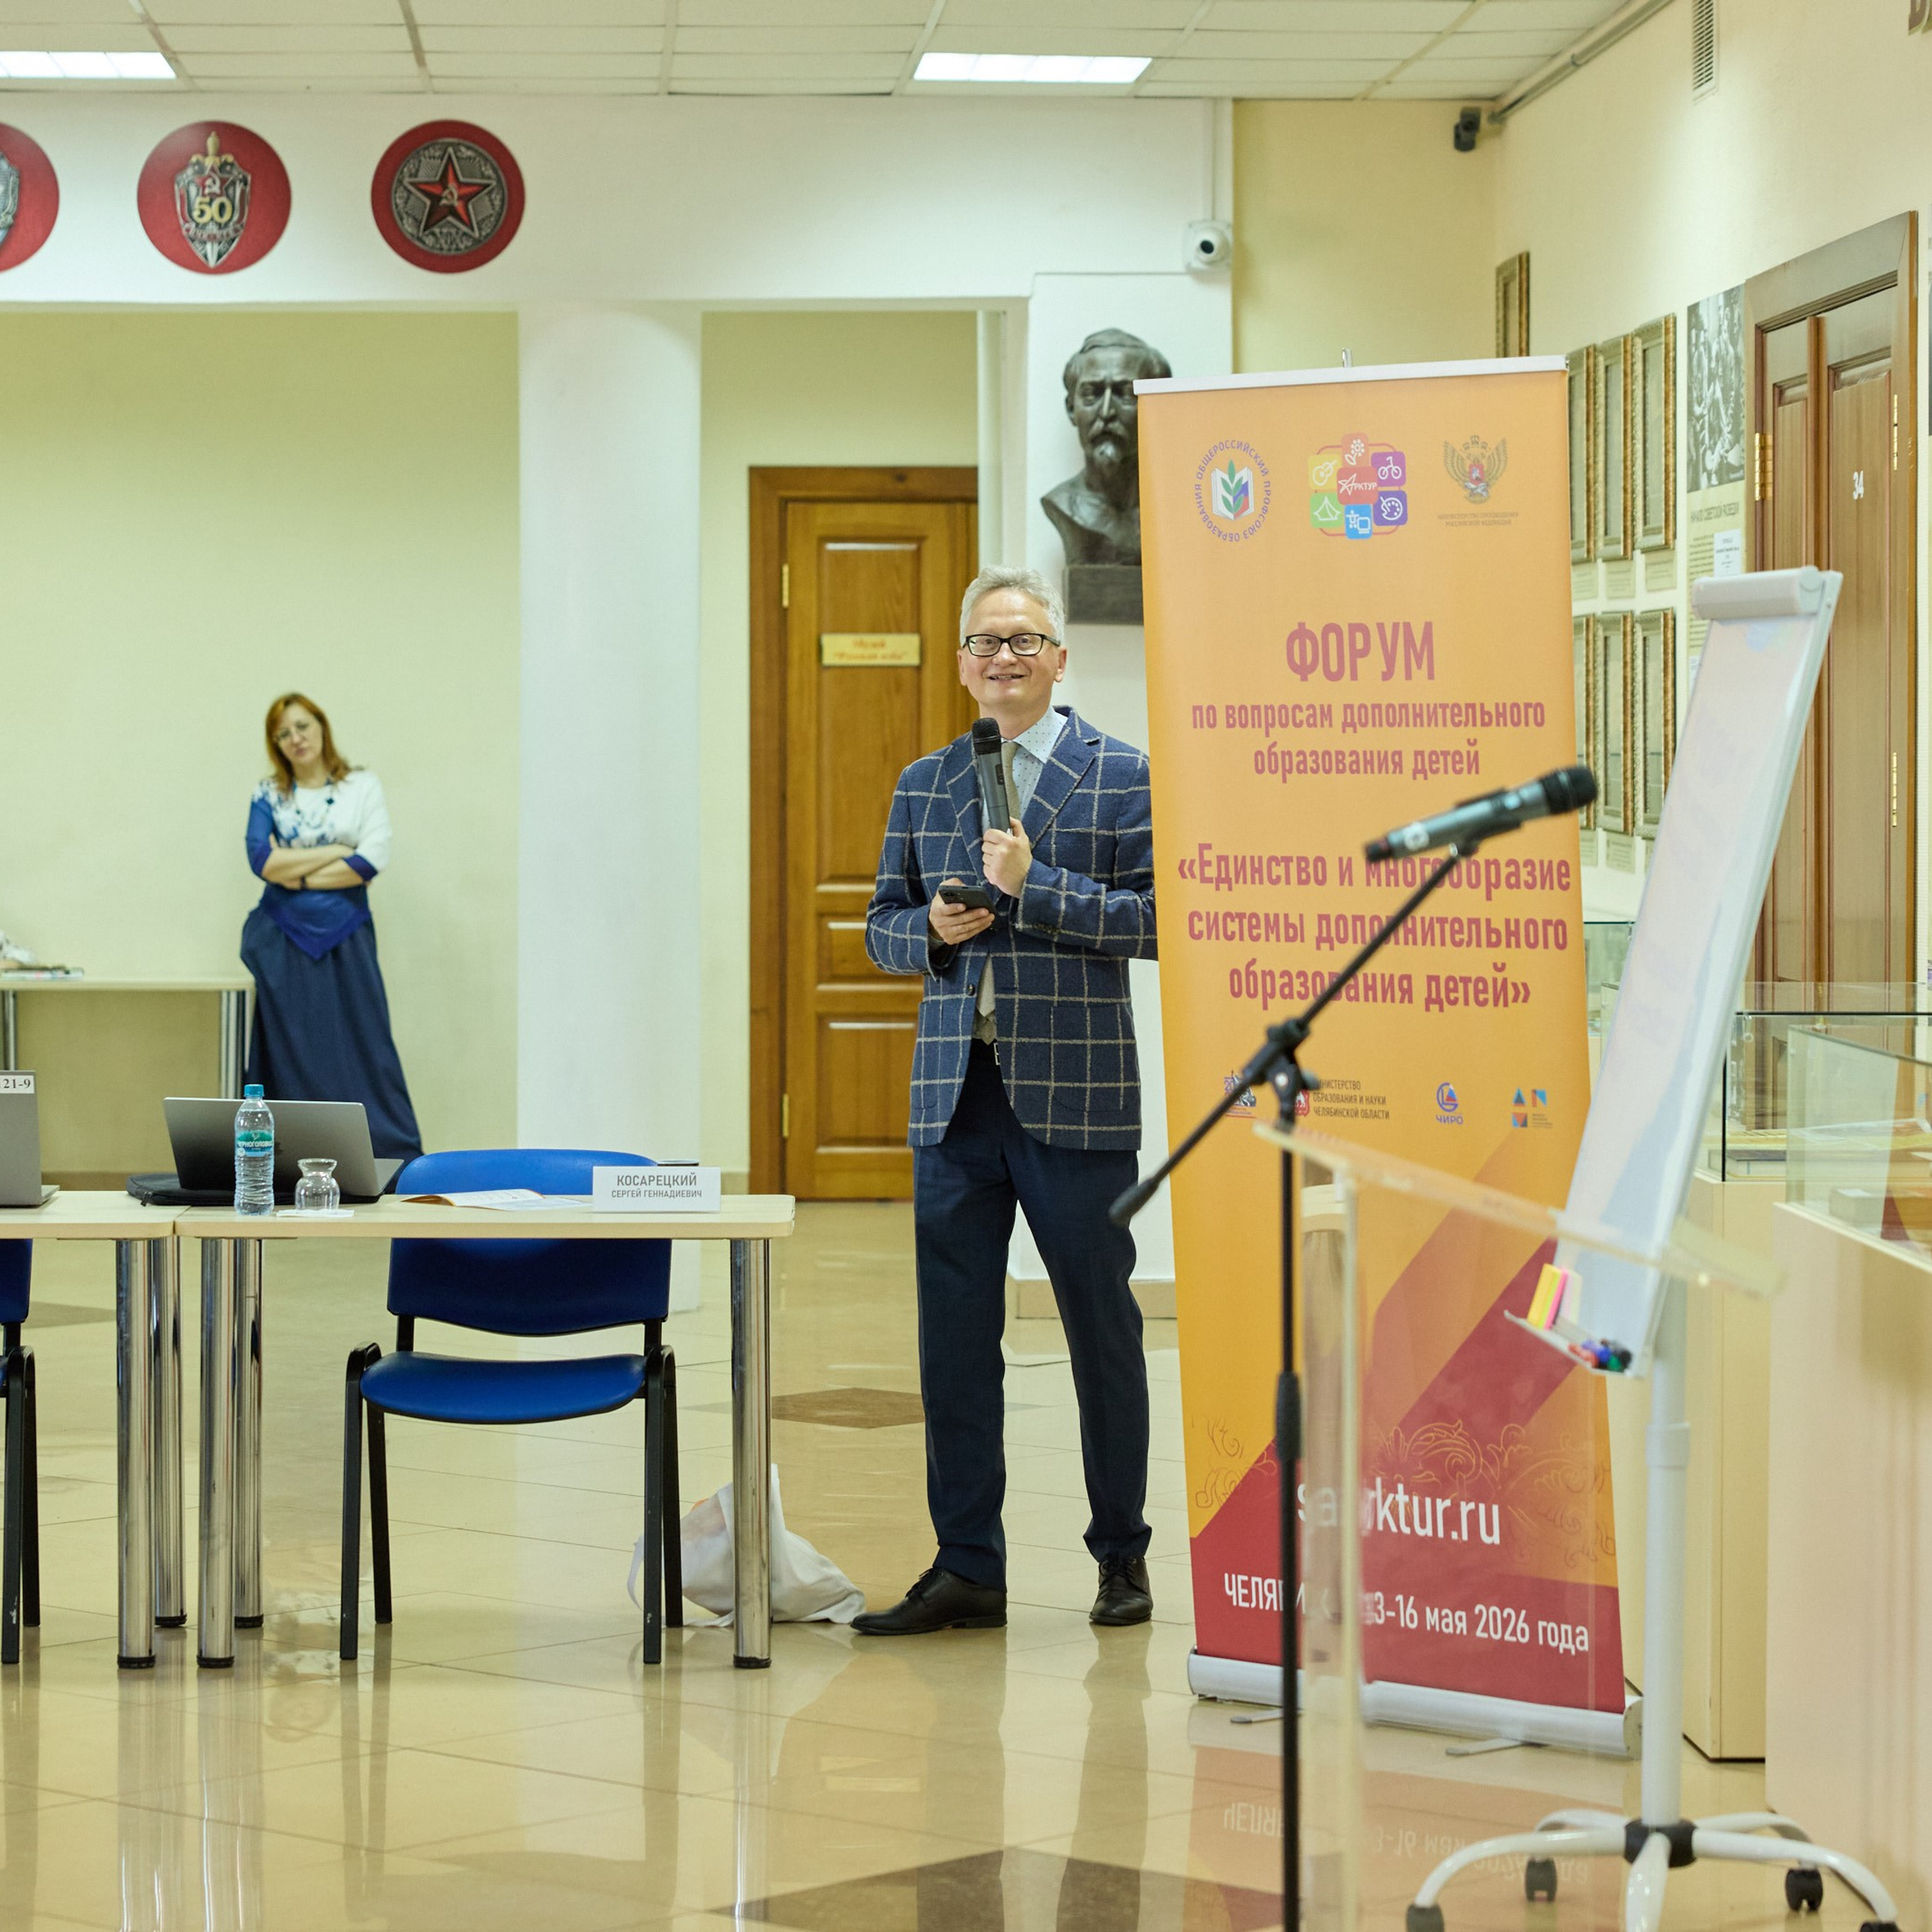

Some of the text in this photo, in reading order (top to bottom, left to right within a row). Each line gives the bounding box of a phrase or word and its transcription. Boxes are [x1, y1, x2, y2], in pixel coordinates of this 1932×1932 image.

[192, 196, 233, 224] 50
[1195, 440, 1271, 542] ОБЩЕРОССИЙСКИЙ ПРОФСОЮЗ ОБРАЗОВАНИЯ
[1854, 470, 1864, 500] 34
[1286, 621, 1435, 681] ФОРУМ
[1192, 701, 1545, 737] по вопросам дополнительного
[1254, 738, 1480, 783] образования детей
[1178, 843, 1327, 891] «Единство
[1338, 856, 1353, 887] и
[1188, 910, 1305, 943] системы
[1425, 962, 1531, 1012] детей»
[1313, 1092, 1386, 1106] ОБРАЗОВАНИЯ И НАУКИ
[1313, 1106, 1389, 1119] ЧЕЛЯБИНСКОЙ ОБЛАСТИ
[1436, 1115, 1464, 1125] ЧИРО
[611, 1189, 702, 1198] СЕРГЕЙ ГЕННАДИЕВИЧ
[617, 1172, 697, 1188] КОСАРЕЦКИЙ
[1297, 1477, 1500, 1546] sarktur.ru
[1426, 1607, 1467, 1635] мая
[1475, 1604, 1530, 1643] 2026
[1537, 1620, 1589, 1655] года
